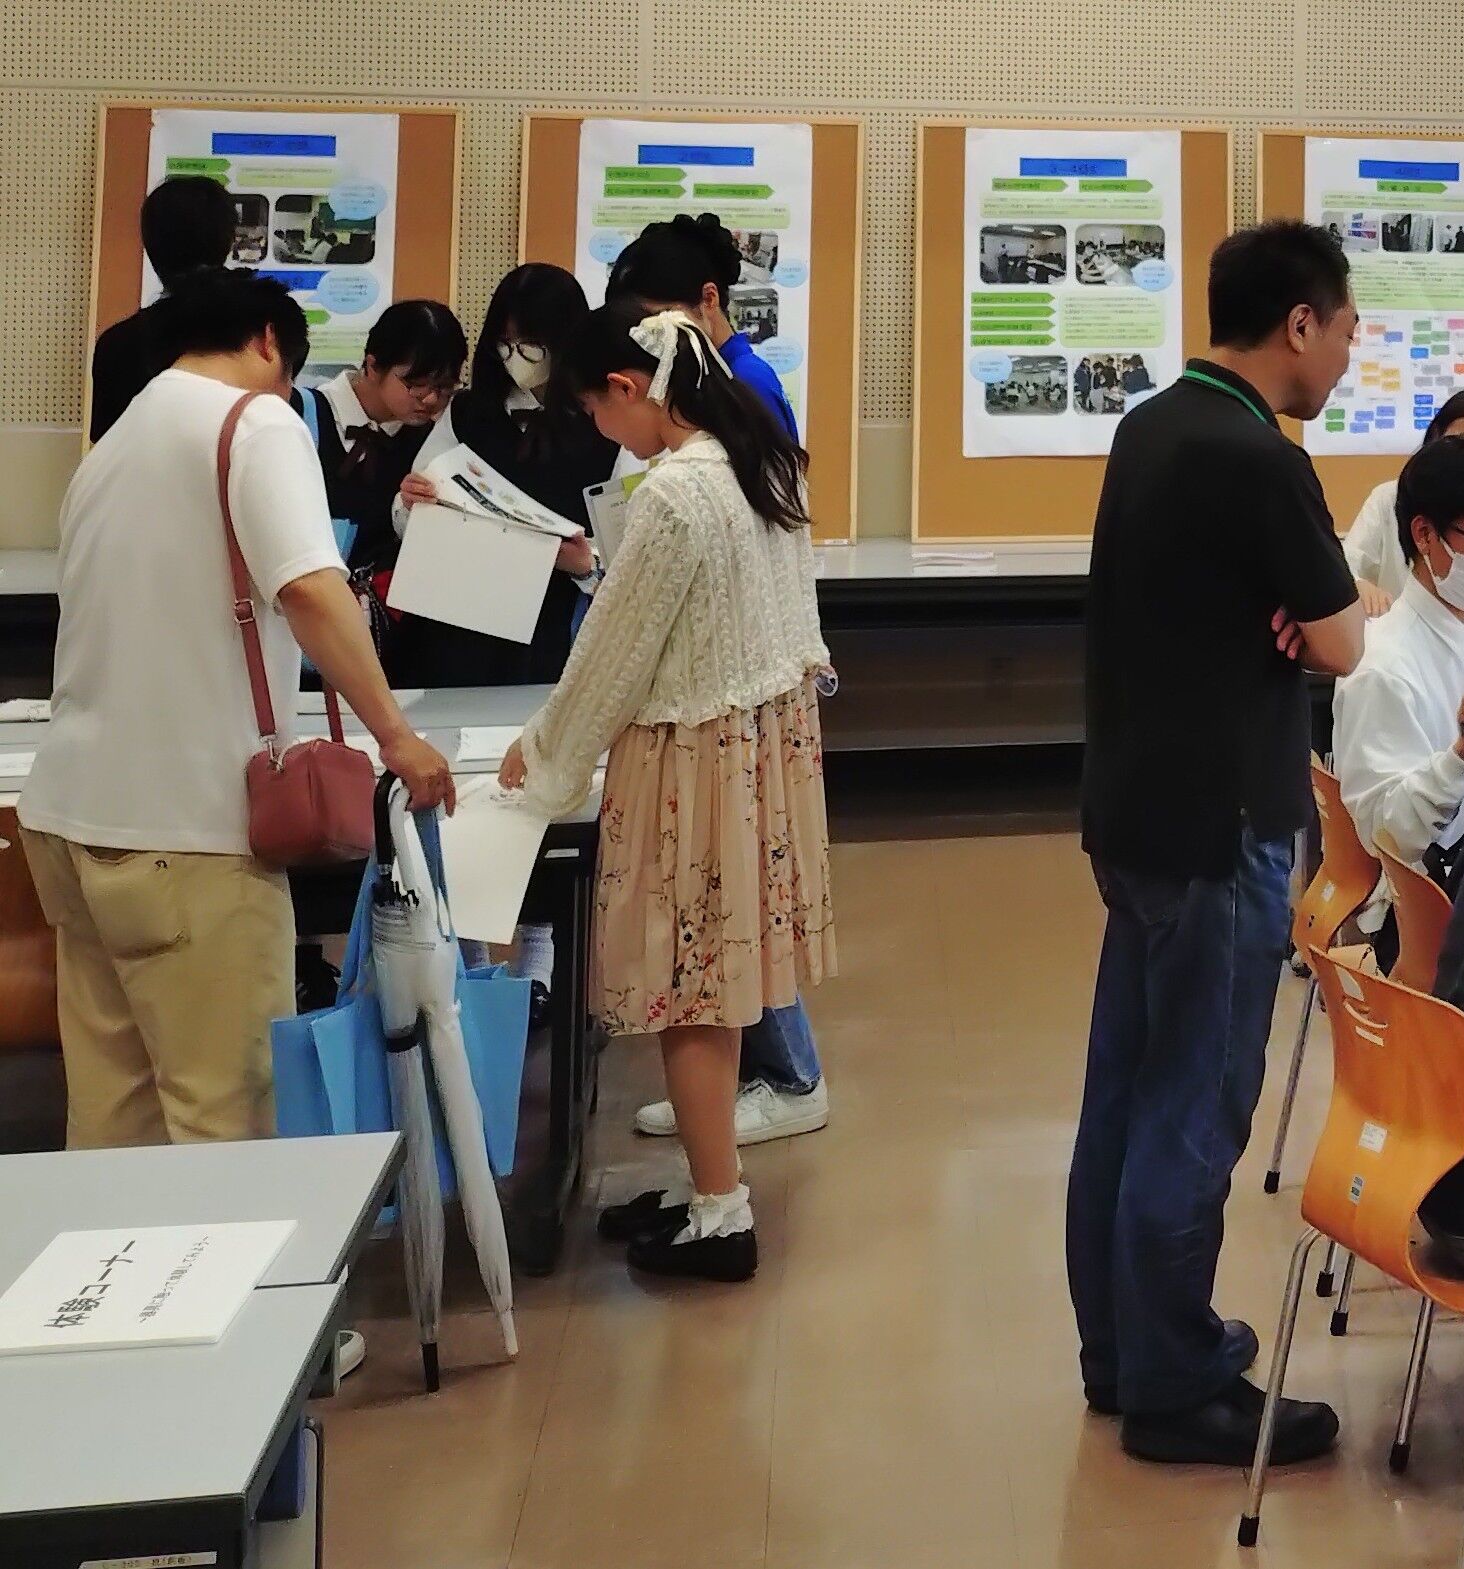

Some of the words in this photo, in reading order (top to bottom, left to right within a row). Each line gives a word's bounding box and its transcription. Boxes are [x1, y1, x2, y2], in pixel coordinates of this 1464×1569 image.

[43, 1240, 136, 1328] 体験コーナー
